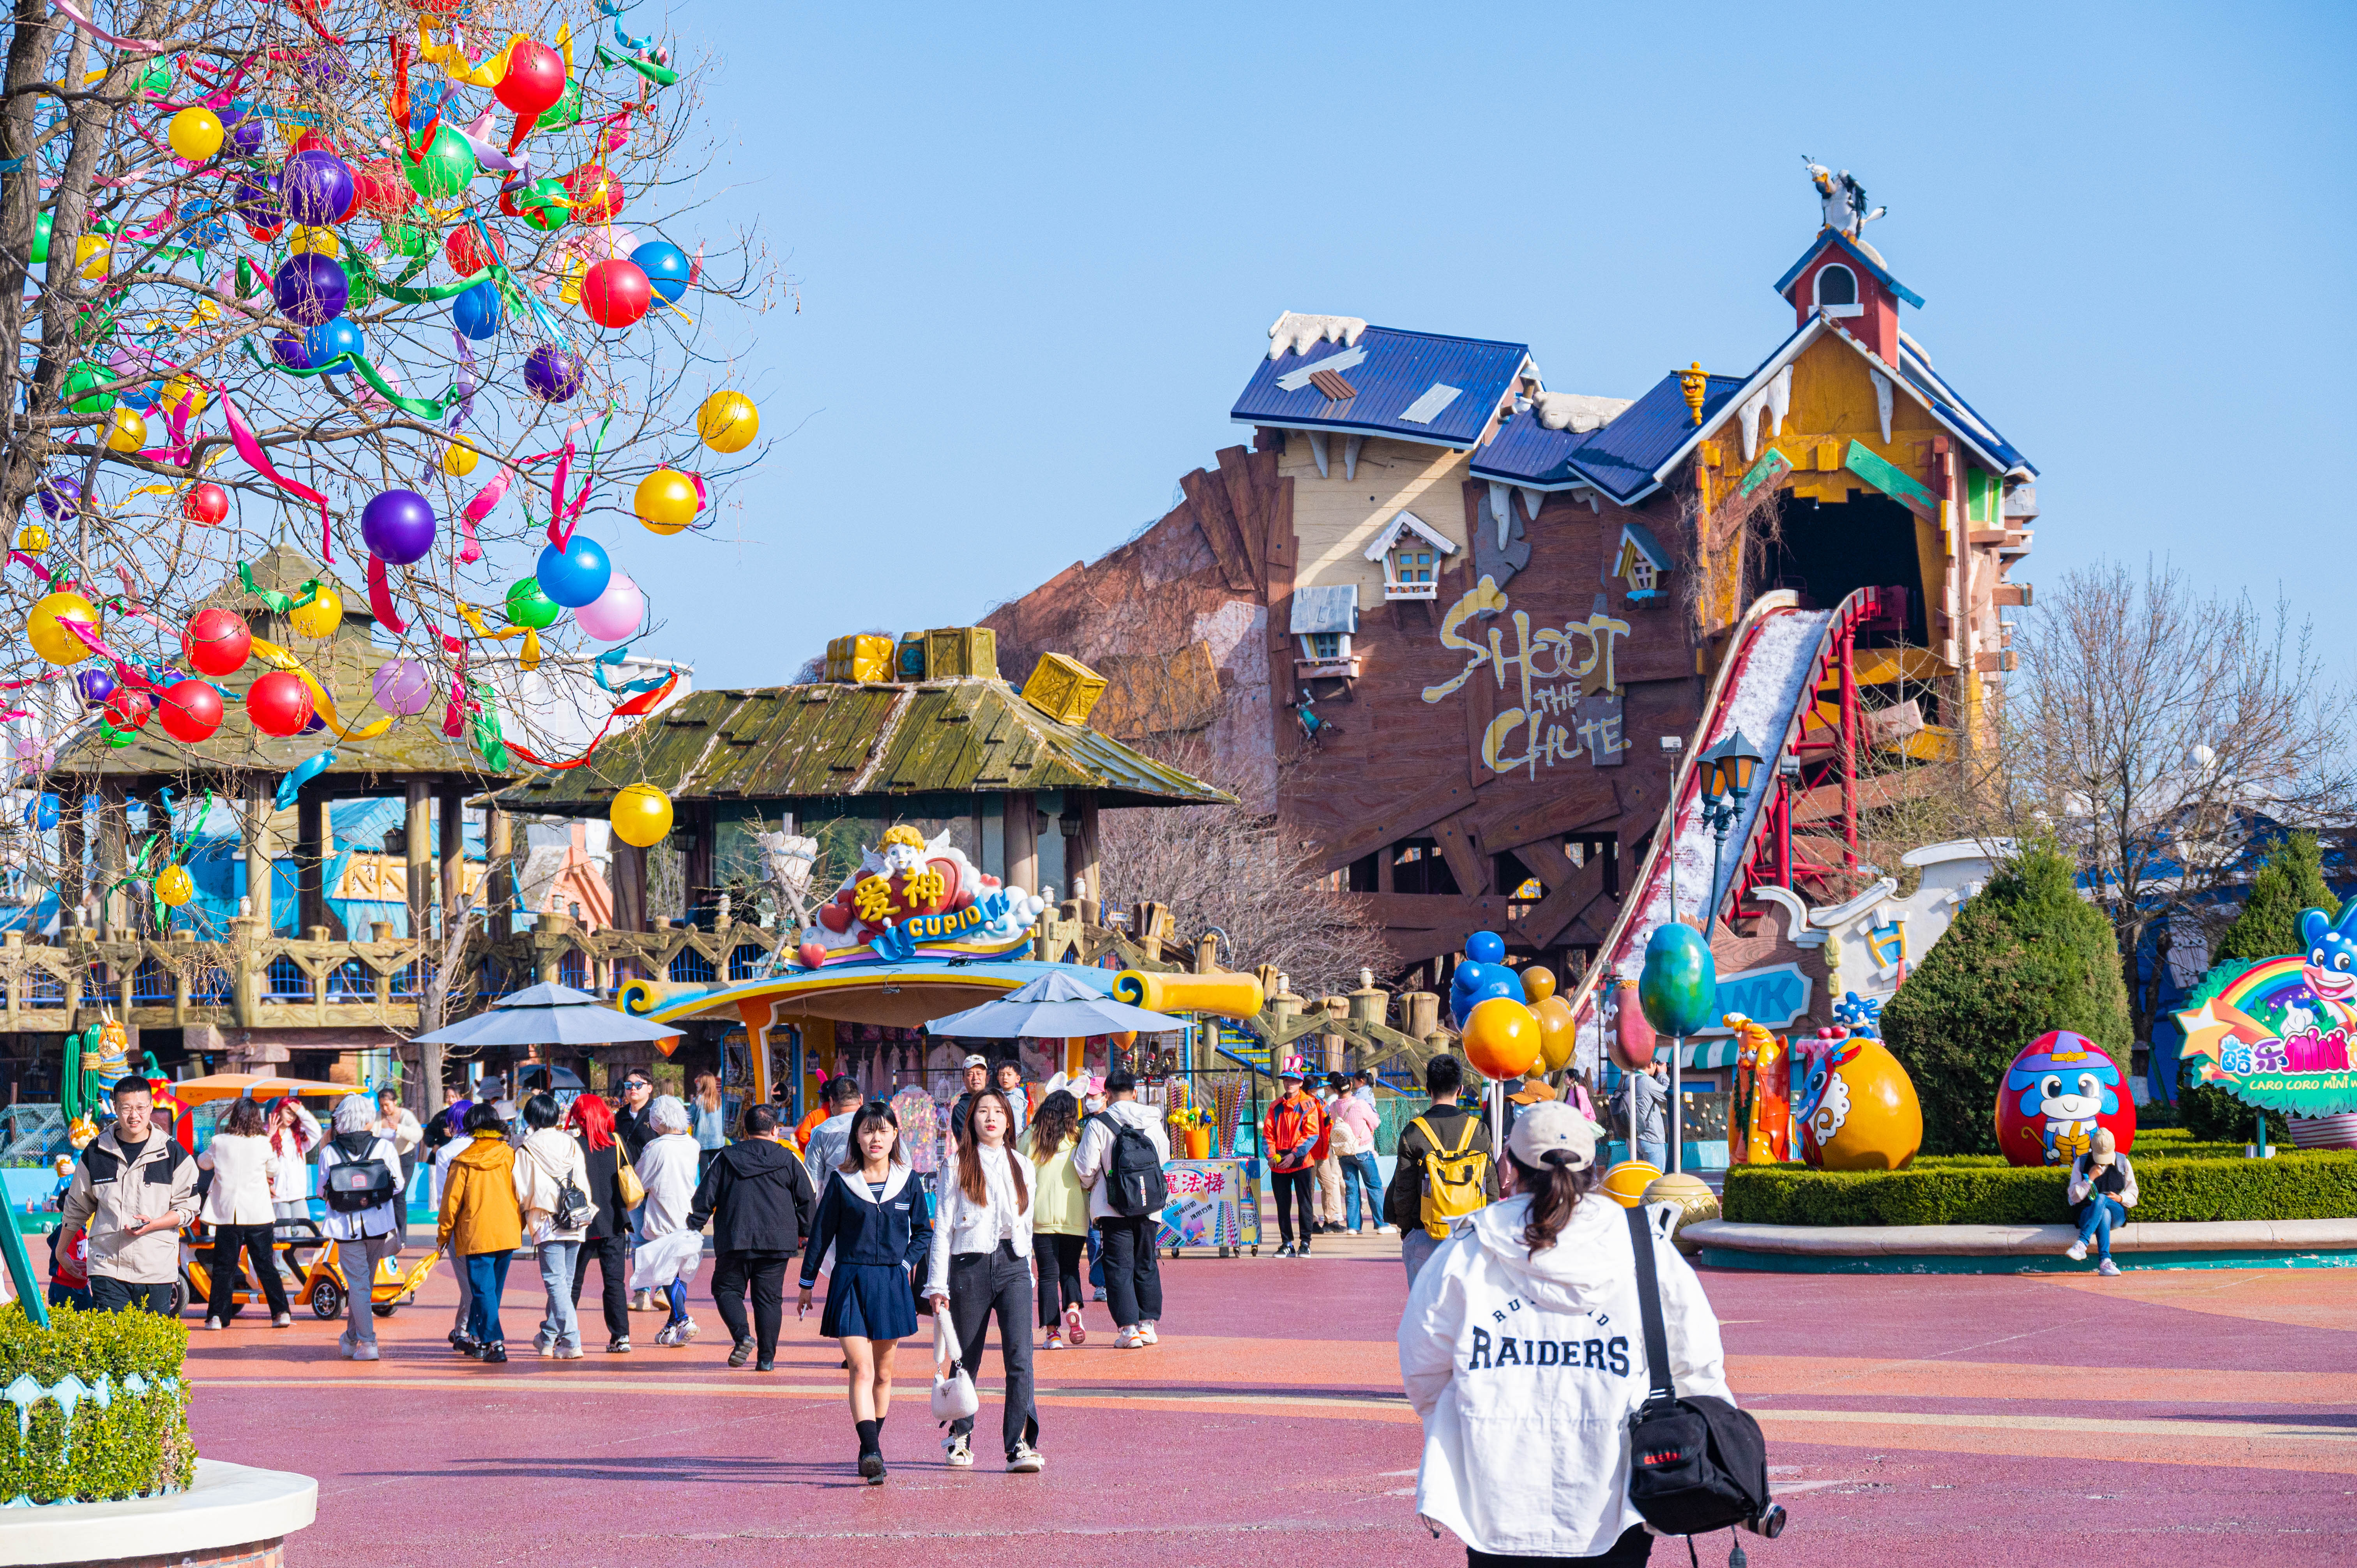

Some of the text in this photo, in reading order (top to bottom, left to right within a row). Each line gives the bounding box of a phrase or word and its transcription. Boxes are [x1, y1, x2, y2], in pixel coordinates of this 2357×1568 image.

[1534, 682, 1581, 716] THE
[853, 865, 945, 922] 爱神
[908, 905, 981, 937] CUPID
[1709, 977, 1793, 1023] ANK
[2249, 1080, 2283, 1090] CARO
[2285, 1080, 2320, 1090] CORO
[1164, 1172, 1226, 1195] 魔法棒
[1162, 1199, 1178, 1211] 无踪
[1173, 1201, 1196, 1217] 伸缩自如
[1190, 1204, 1214, 1220] 携带方便
[1468, 1325, 1629, 1378] RAIDERS
